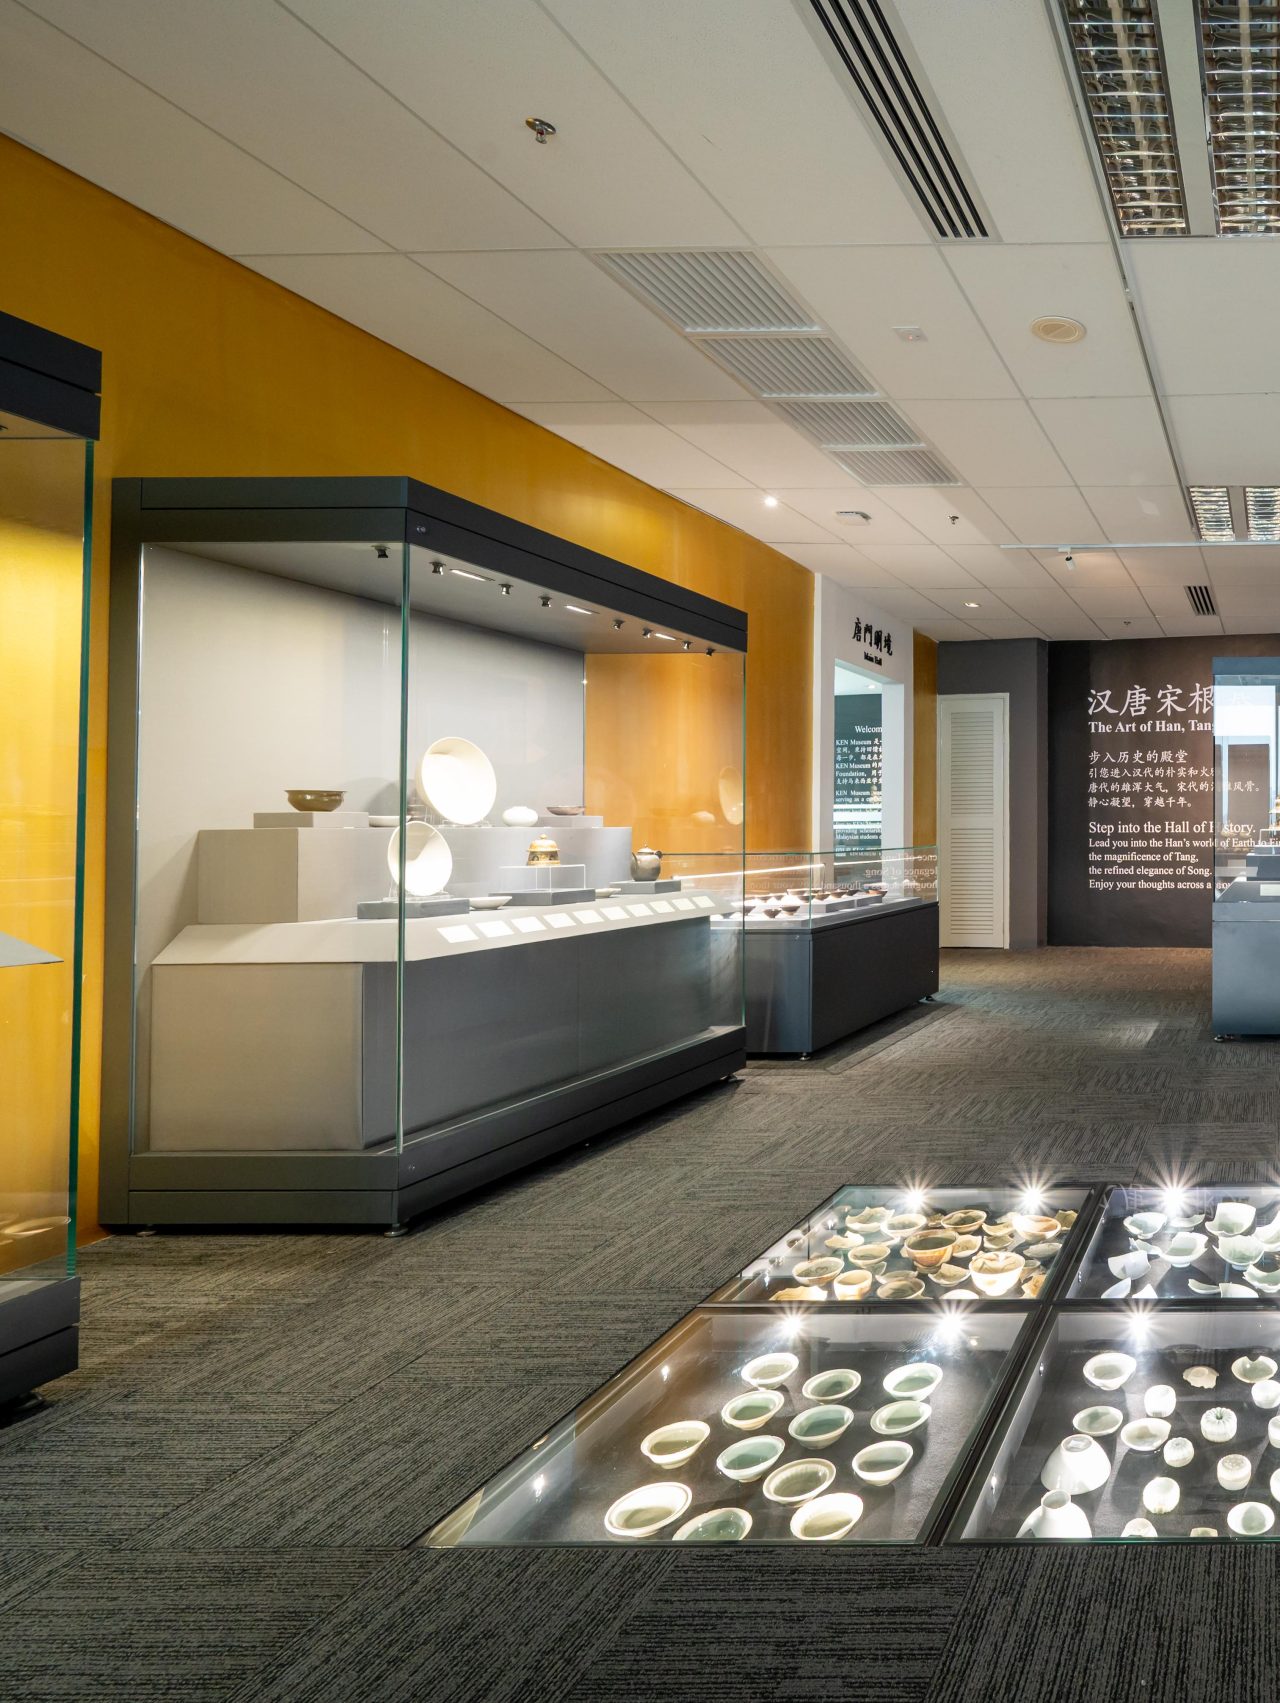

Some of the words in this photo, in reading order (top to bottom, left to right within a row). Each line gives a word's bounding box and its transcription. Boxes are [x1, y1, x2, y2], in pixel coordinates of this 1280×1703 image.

[1088, 722, 1112, 733] The
[1115, 721, 1136, 732] Art
[1139, 721, 1153, 732] of
[1155, 720, 1185, 733] Han,
[1088, 749, 1188, 765] 步入历史的殿堂
[1089, 821, 1115, 836] Step
[1118, 821, 1140, 833] into
[1143, 821, 1162, 833] the
[1165, 821, 1190, 833] Hall
[1193, 821, 1207, 833] of
[1209, 821, 1256, 835] Hstory.
[1089, 838, 1110, 848] Lead
[1112, 840, 1128, 850] you
[1130, 838, 1147, 848] into
[1149, 838, 1163, 848] the
[1220, 838, 1231, 848] of
[1232, 838, 1256, 848] Earth
[1089, 852, 1102, 861] the
[1104, 852, 1161, 863] magnificence
[1163, 852, 1174, 861] of
[1174, 852, 1199, 863] Tang,
[1089, 866, 1102, 875] the
[1104, 866, 1134, 875] refined
[1136, 866, 1174, 877] elegance
[1176, 866, 1187, 875] of
[1188, 866, 1212, 877] Song.
[1089, 879, 1114, 891] Enjoy
[1116, 881, 1136, 891] your
[1138, 880, 1175, 891] thoughts
[1177, 881, 1204, 889] across
[1206, 881, 1212, 889] a
